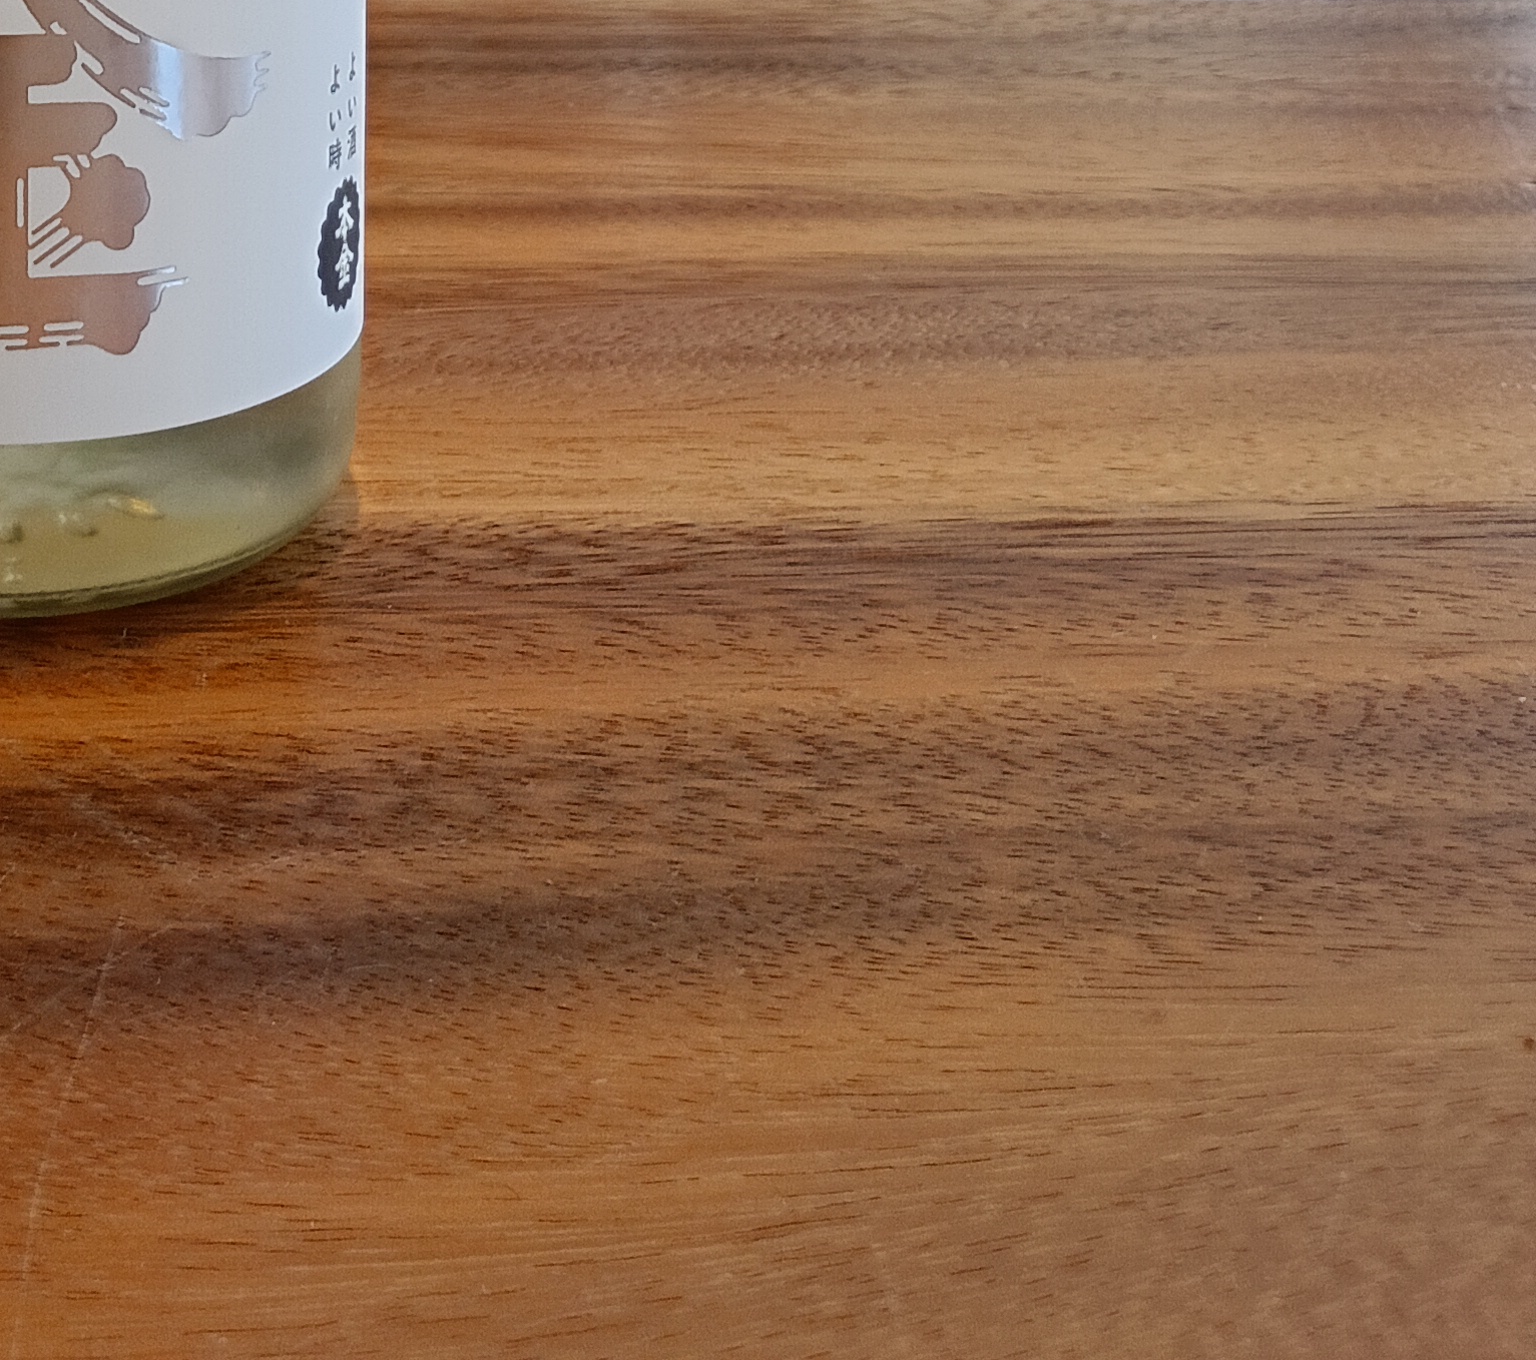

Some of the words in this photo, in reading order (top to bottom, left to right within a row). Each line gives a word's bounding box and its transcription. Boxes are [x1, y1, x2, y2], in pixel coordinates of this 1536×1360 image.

[328, 64, 342, 170] よい時
[347, 51, 357, 160] よい酒
[335, 194, 354, 291] 本金
